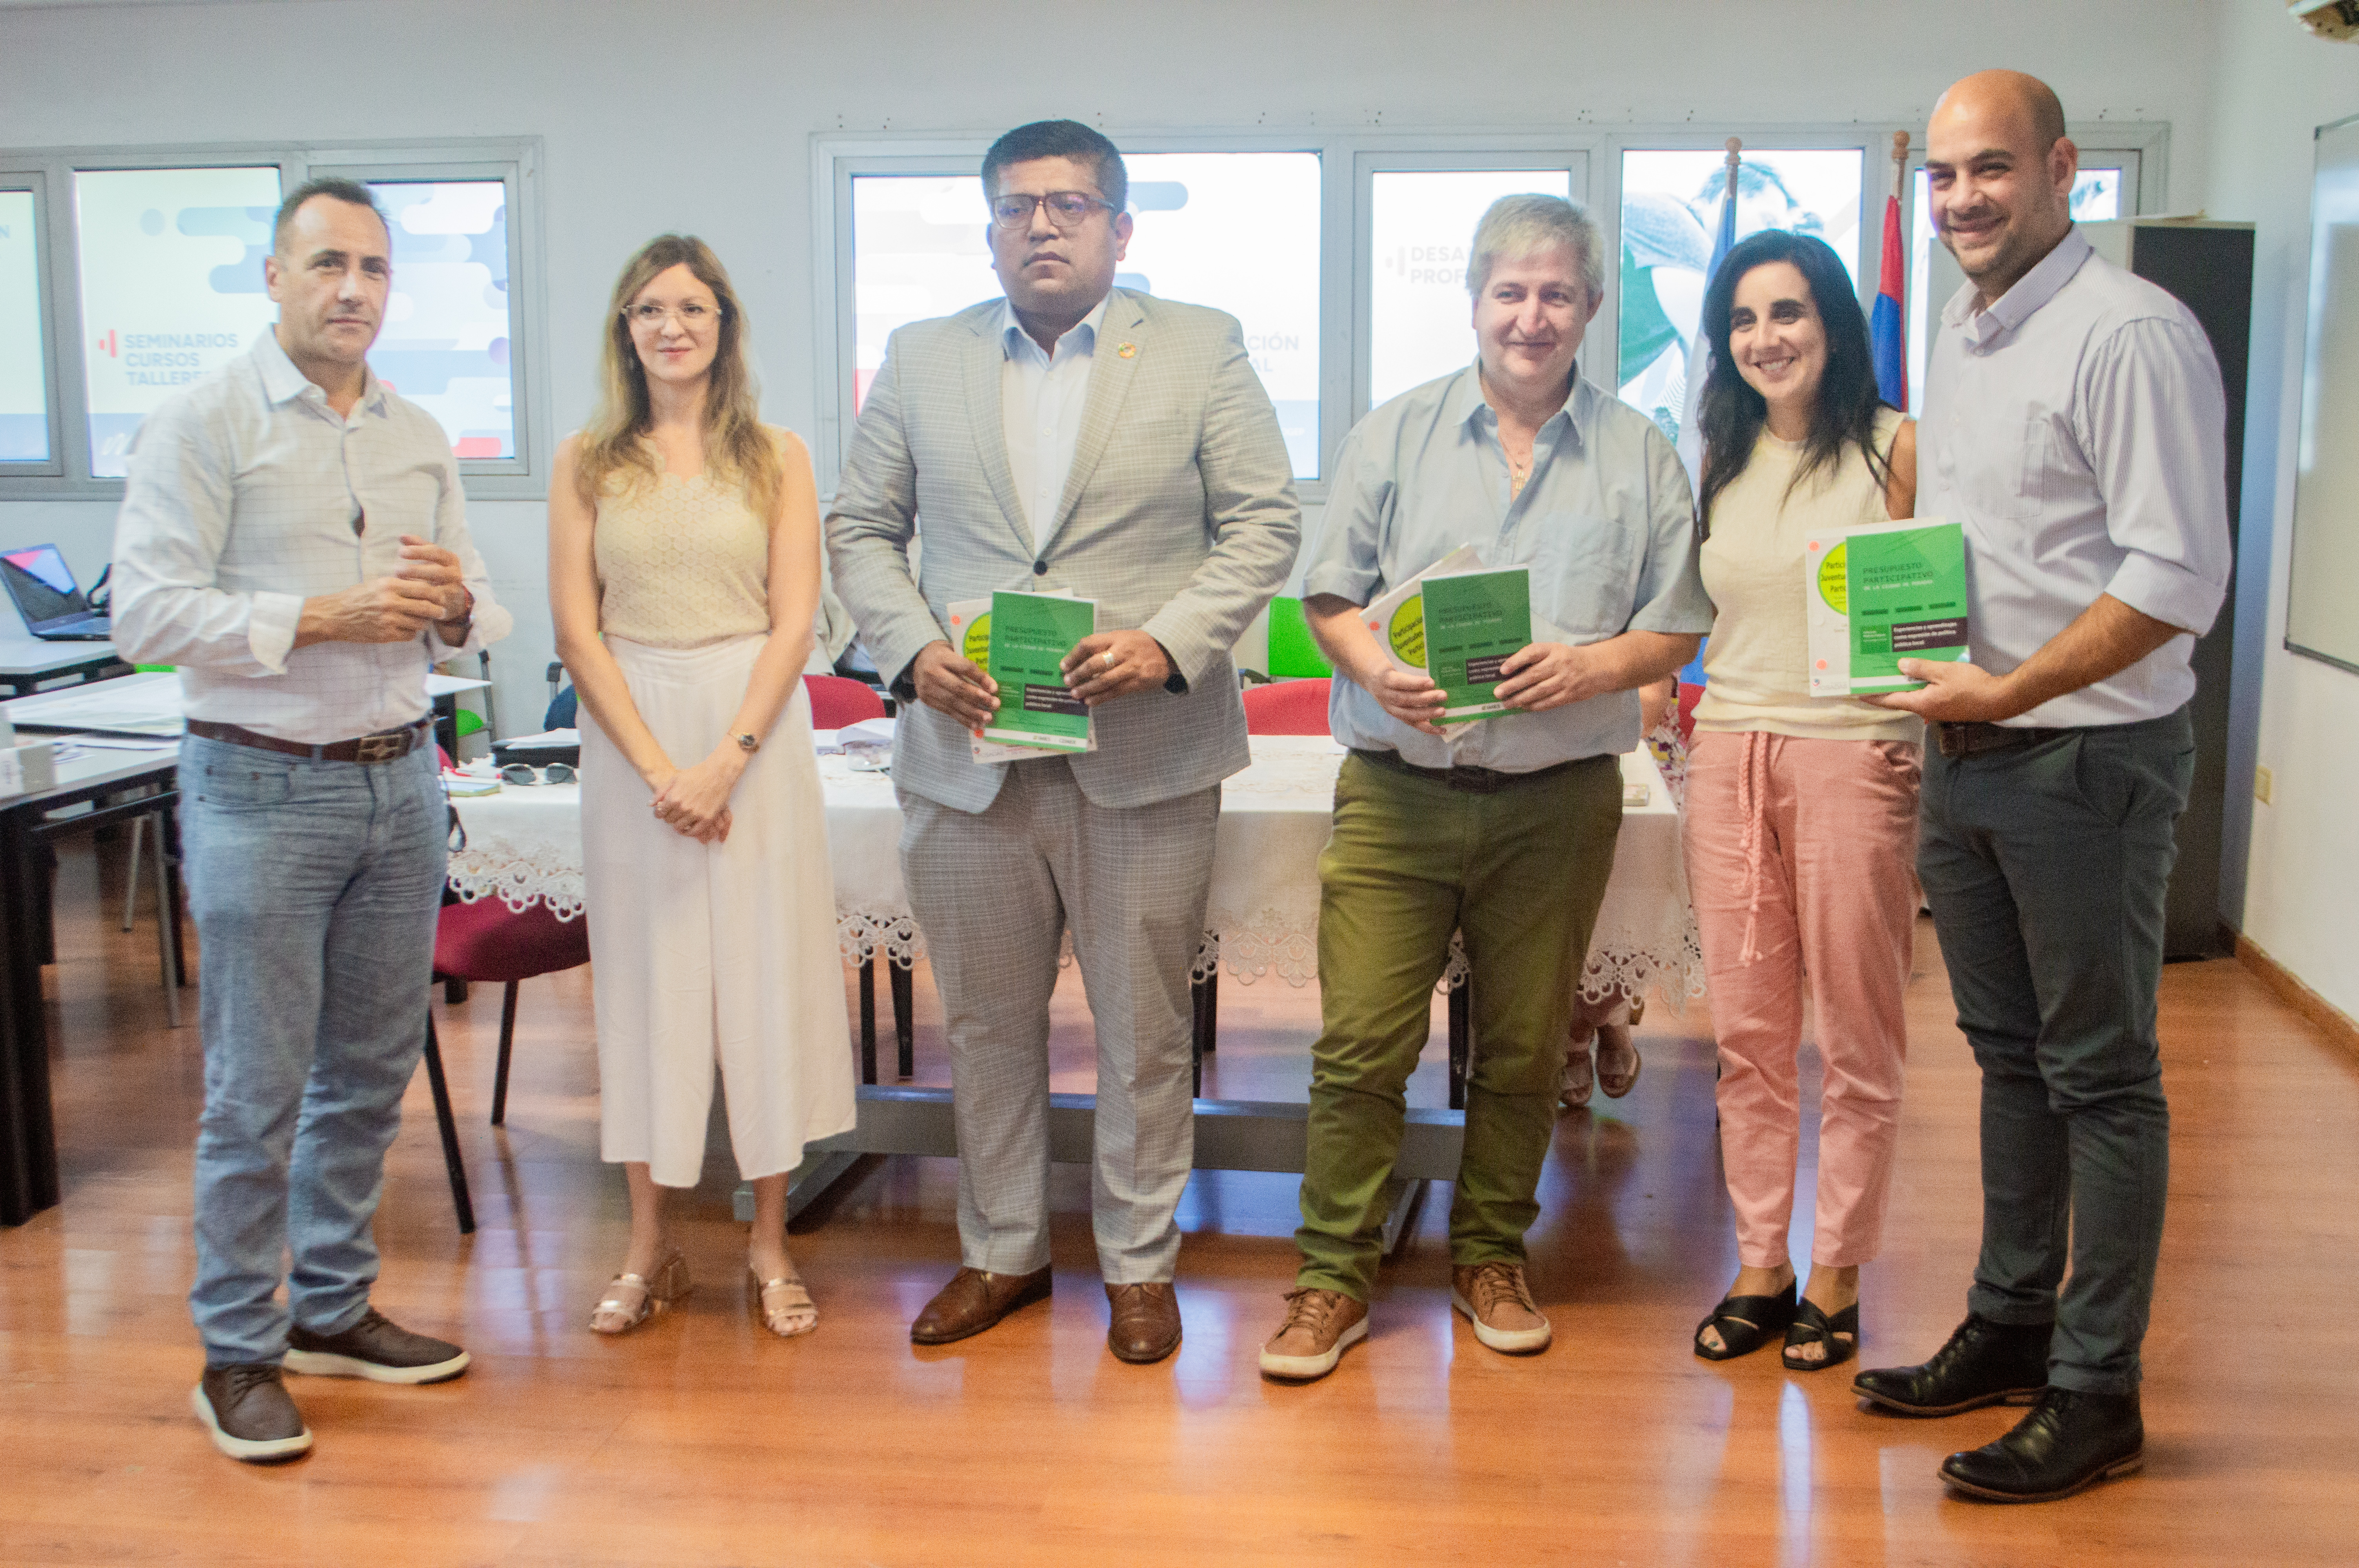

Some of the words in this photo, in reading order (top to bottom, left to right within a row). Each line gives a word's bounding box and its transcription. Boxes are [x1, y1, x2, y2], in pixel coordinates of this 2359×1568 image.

[1411, 246, 1468, 261] DESA
[1410, 269, 1466, 284] PROF
[124, 333, 238, 348] SEMINARIOS
[1247, 332, 1299, 350] CIÓN
[125, 352, 200, 367] CURSOS
[1251, 357, 1273, 372] AL
[125, 371, 211, 386] TALLERE
[1863, 561, 1921, 575] PRESUPUESTO
[1863, 570, 1933, 584] PARTICIPATIVO
